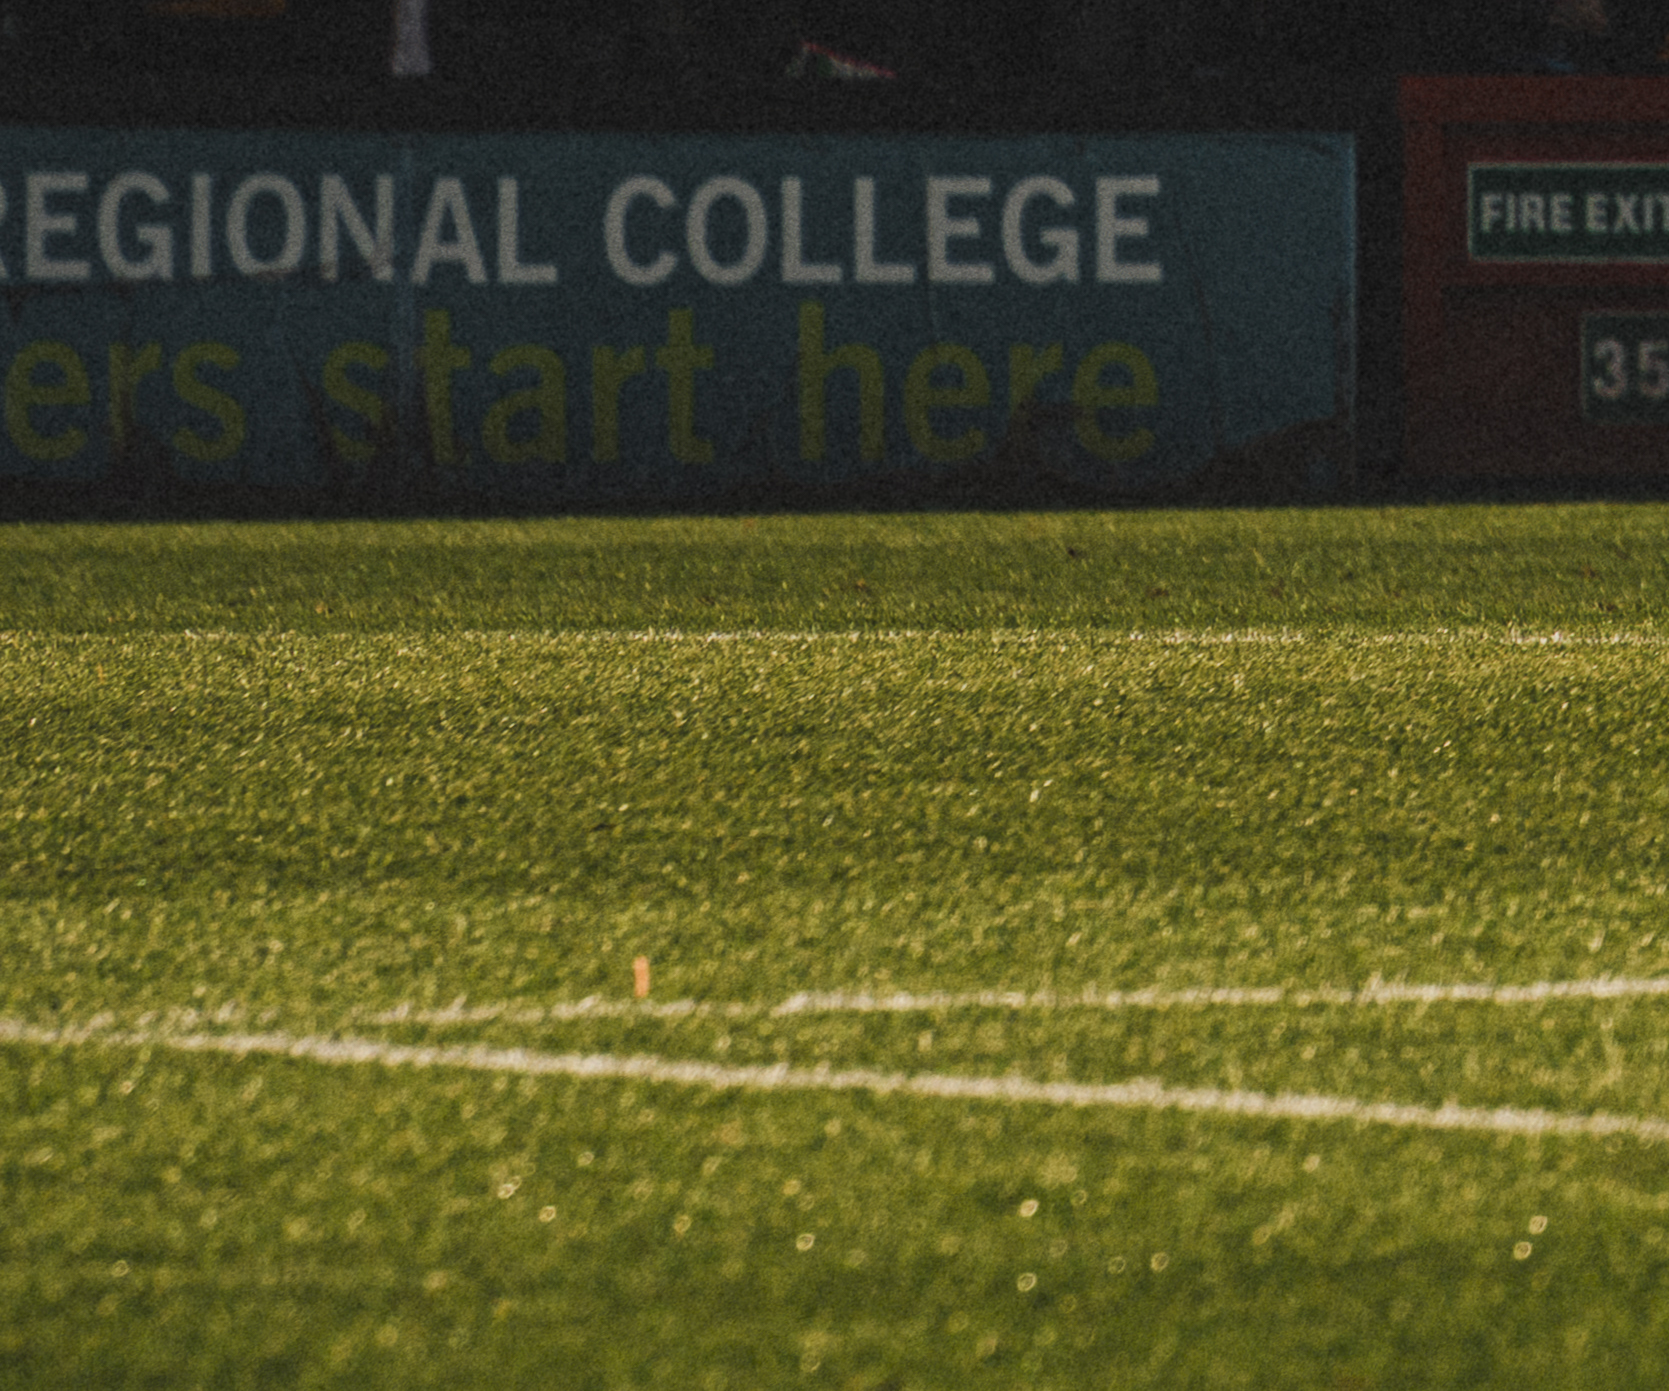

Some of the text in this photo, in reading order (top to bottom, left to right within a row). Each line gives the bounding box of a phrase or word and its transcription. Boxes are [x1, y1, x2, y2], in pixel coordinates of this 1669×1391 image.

[0, 171, 1165, 285] EGIONAL COLLEGE
[1479, 190, 1574, 236] FIRE
[319, 307, 717, 466] start
[798, 299, 1161, 465] here
